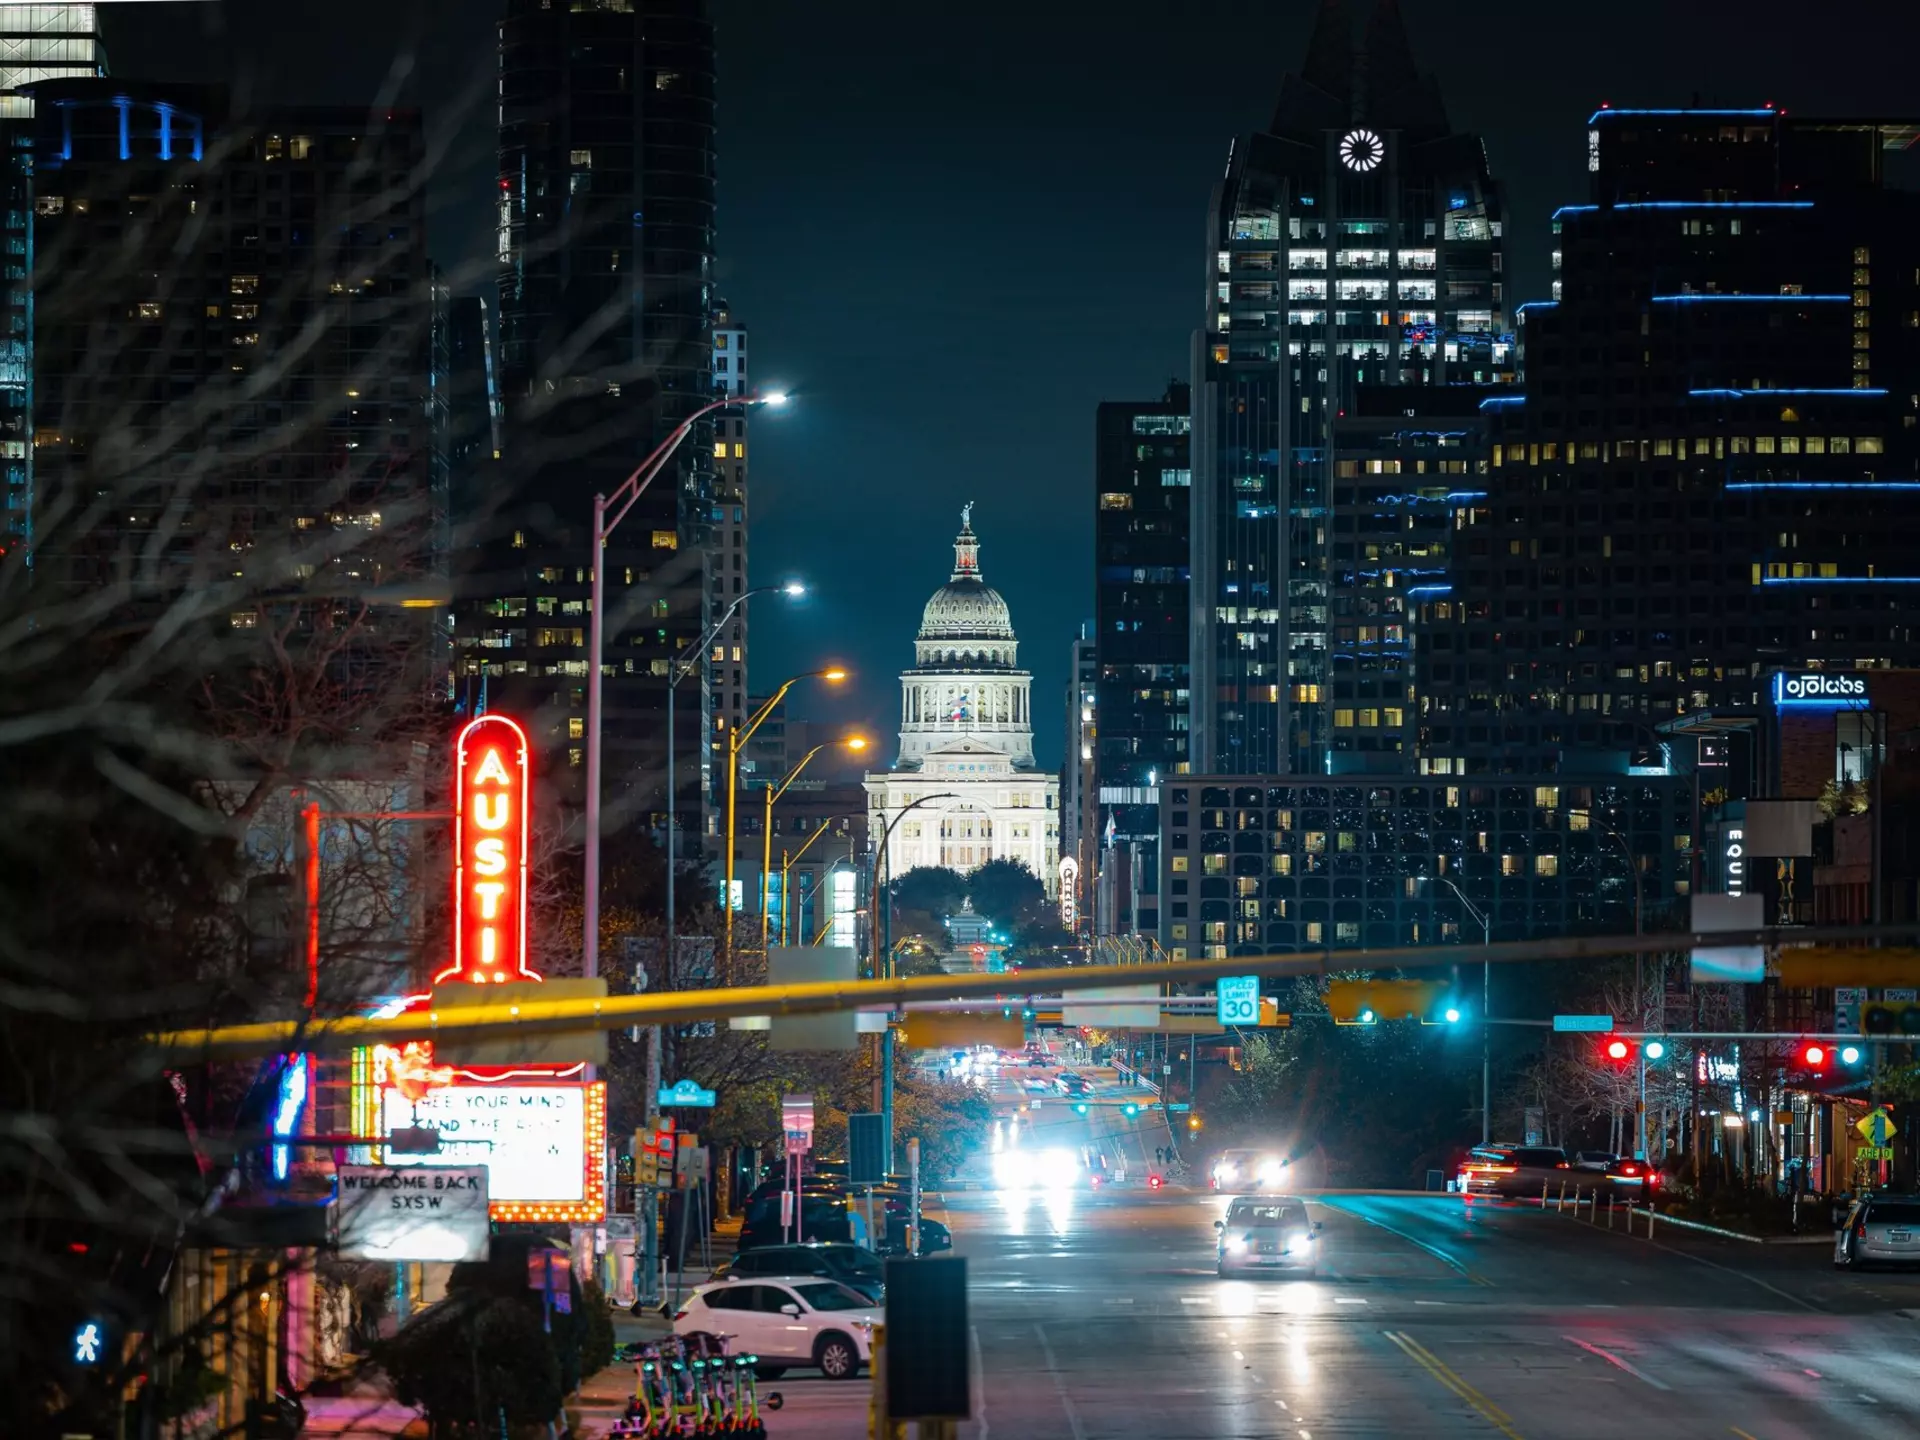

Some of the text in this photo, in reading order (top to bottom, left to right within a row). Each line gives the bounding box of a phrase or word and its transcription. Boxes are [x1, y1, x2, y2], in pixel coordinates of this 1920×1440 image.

[1226, 991, 1251, 999] LIMIT
[1225, 1001, 1252, 1018] 30
[465, 1096, 509, 1109] YOUR
[519, 1096, 566, 1109] MIND
[427, 1118, 460, 1132] AND
[1861, 1148, 1890, 1158] AHED
[343, 1175, 479, 1190] WELCOME BACK
[391, 1195, 443, 1209] SXSW
